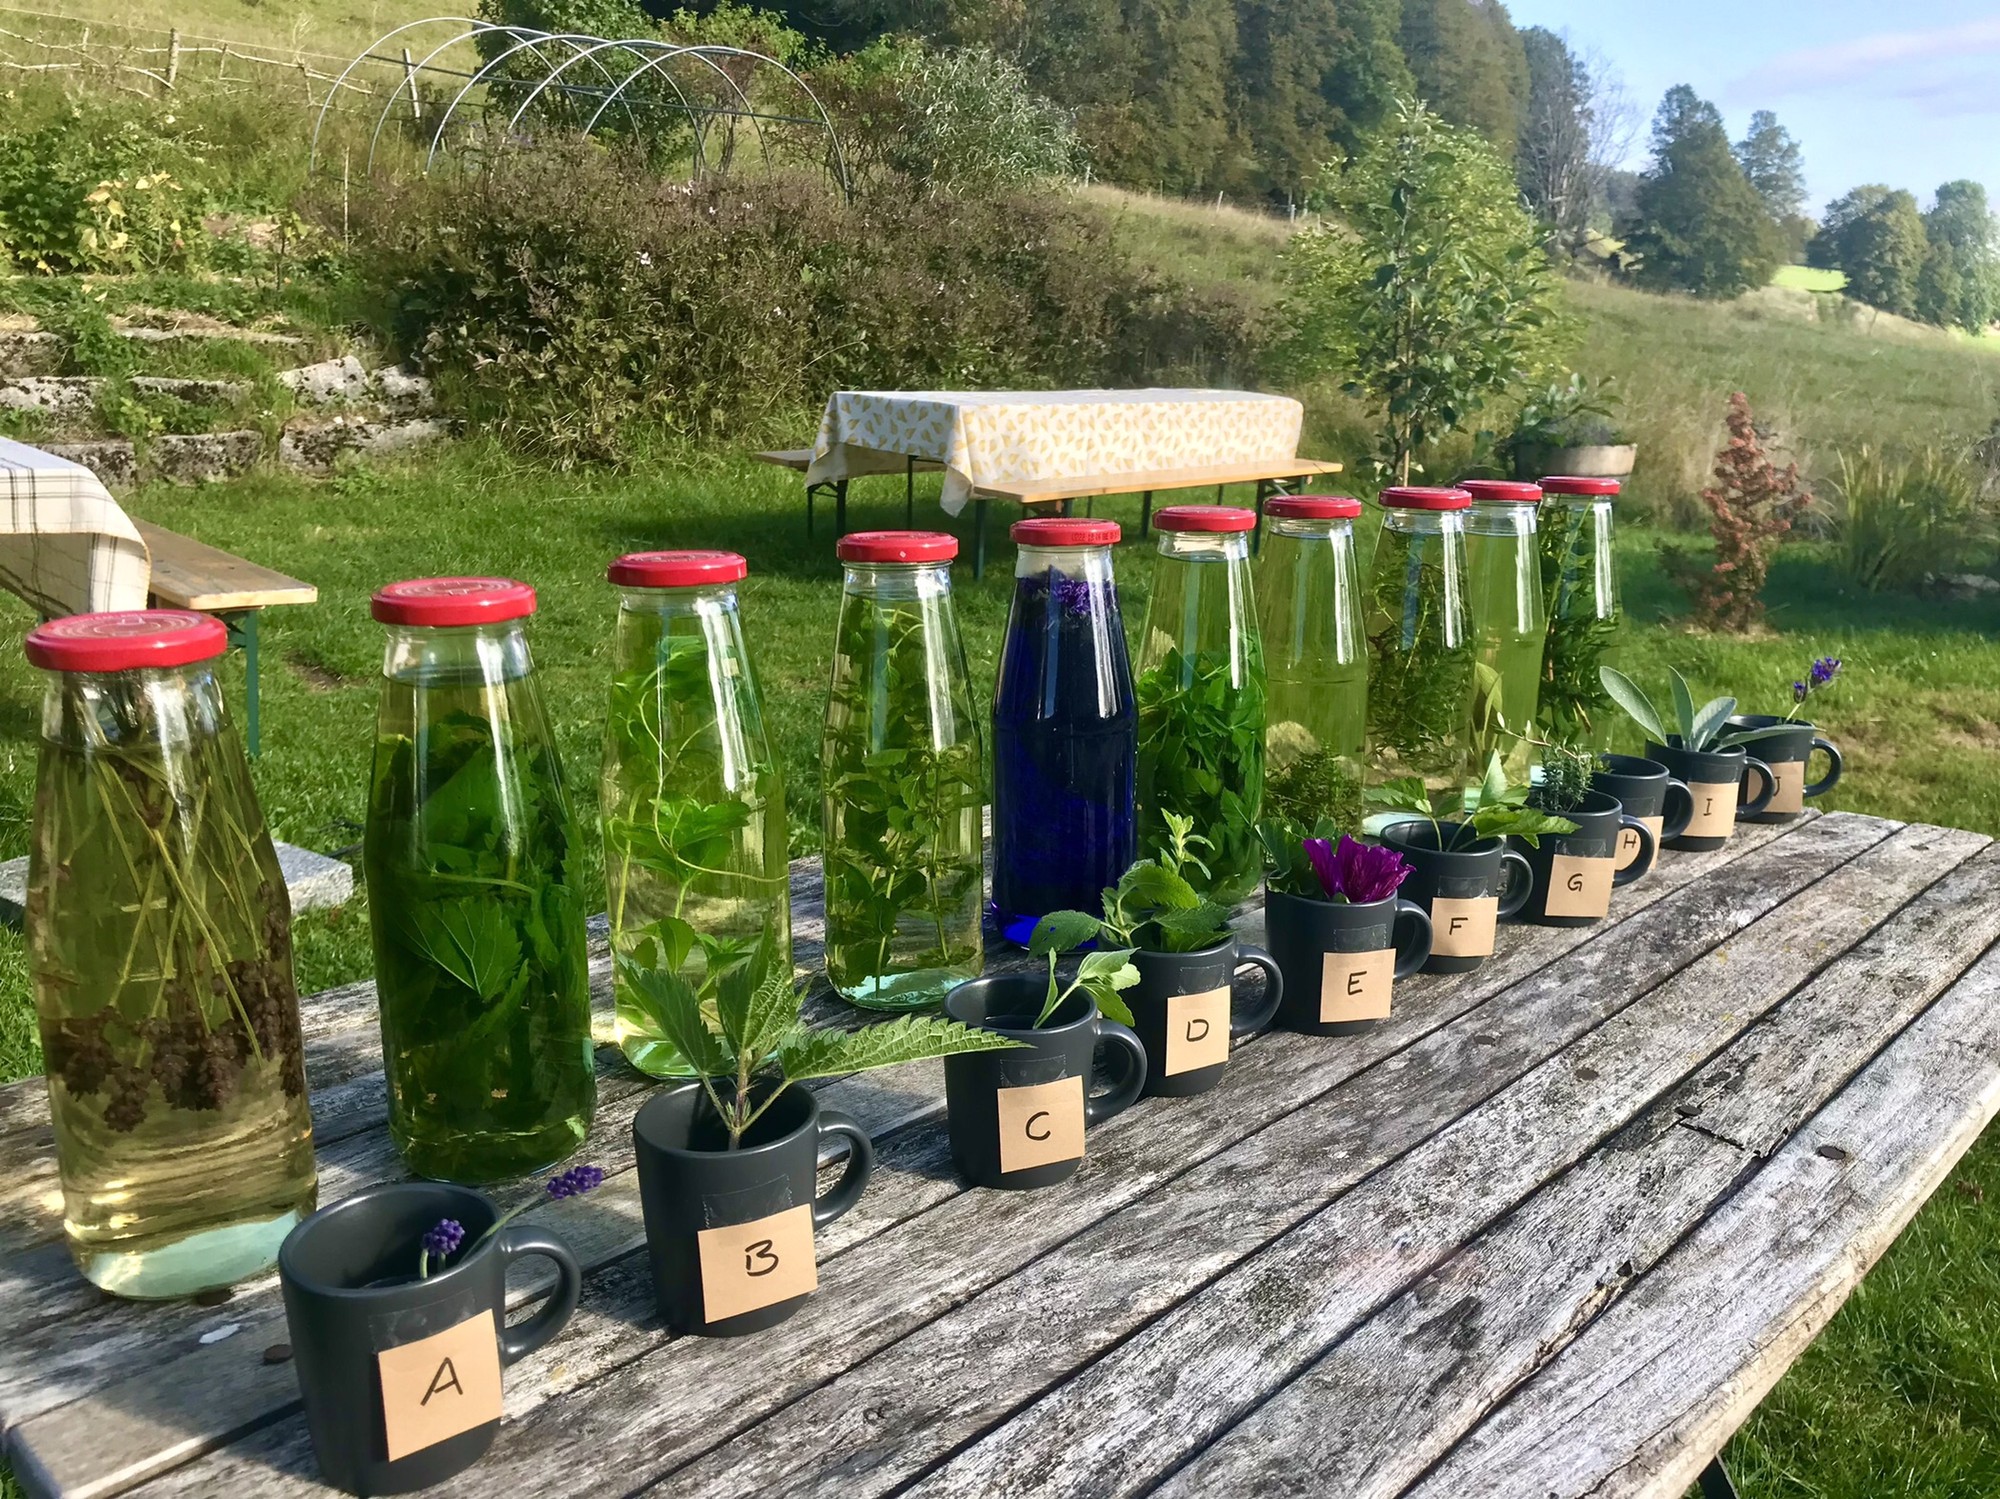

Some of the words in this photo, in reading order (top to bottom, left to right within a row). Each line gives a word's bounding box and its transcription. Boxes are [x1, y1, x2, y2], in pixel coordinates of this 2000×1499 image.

[1773, 776, 1782, 797] J
[1703, 798, 1713, 816] I
[1622, 833, 1638, 849] H
[1567, 872, 1583, 892] G
[1448, 917, 1469, 936] F
[1347, 970, 1368, 996] E
[1185, 1018, 1210, 1043] D
[1025, 1110, 1052, 1142] C
[744, 1239, 780, 1277] B
[420, 1356, 464, 1407] A
